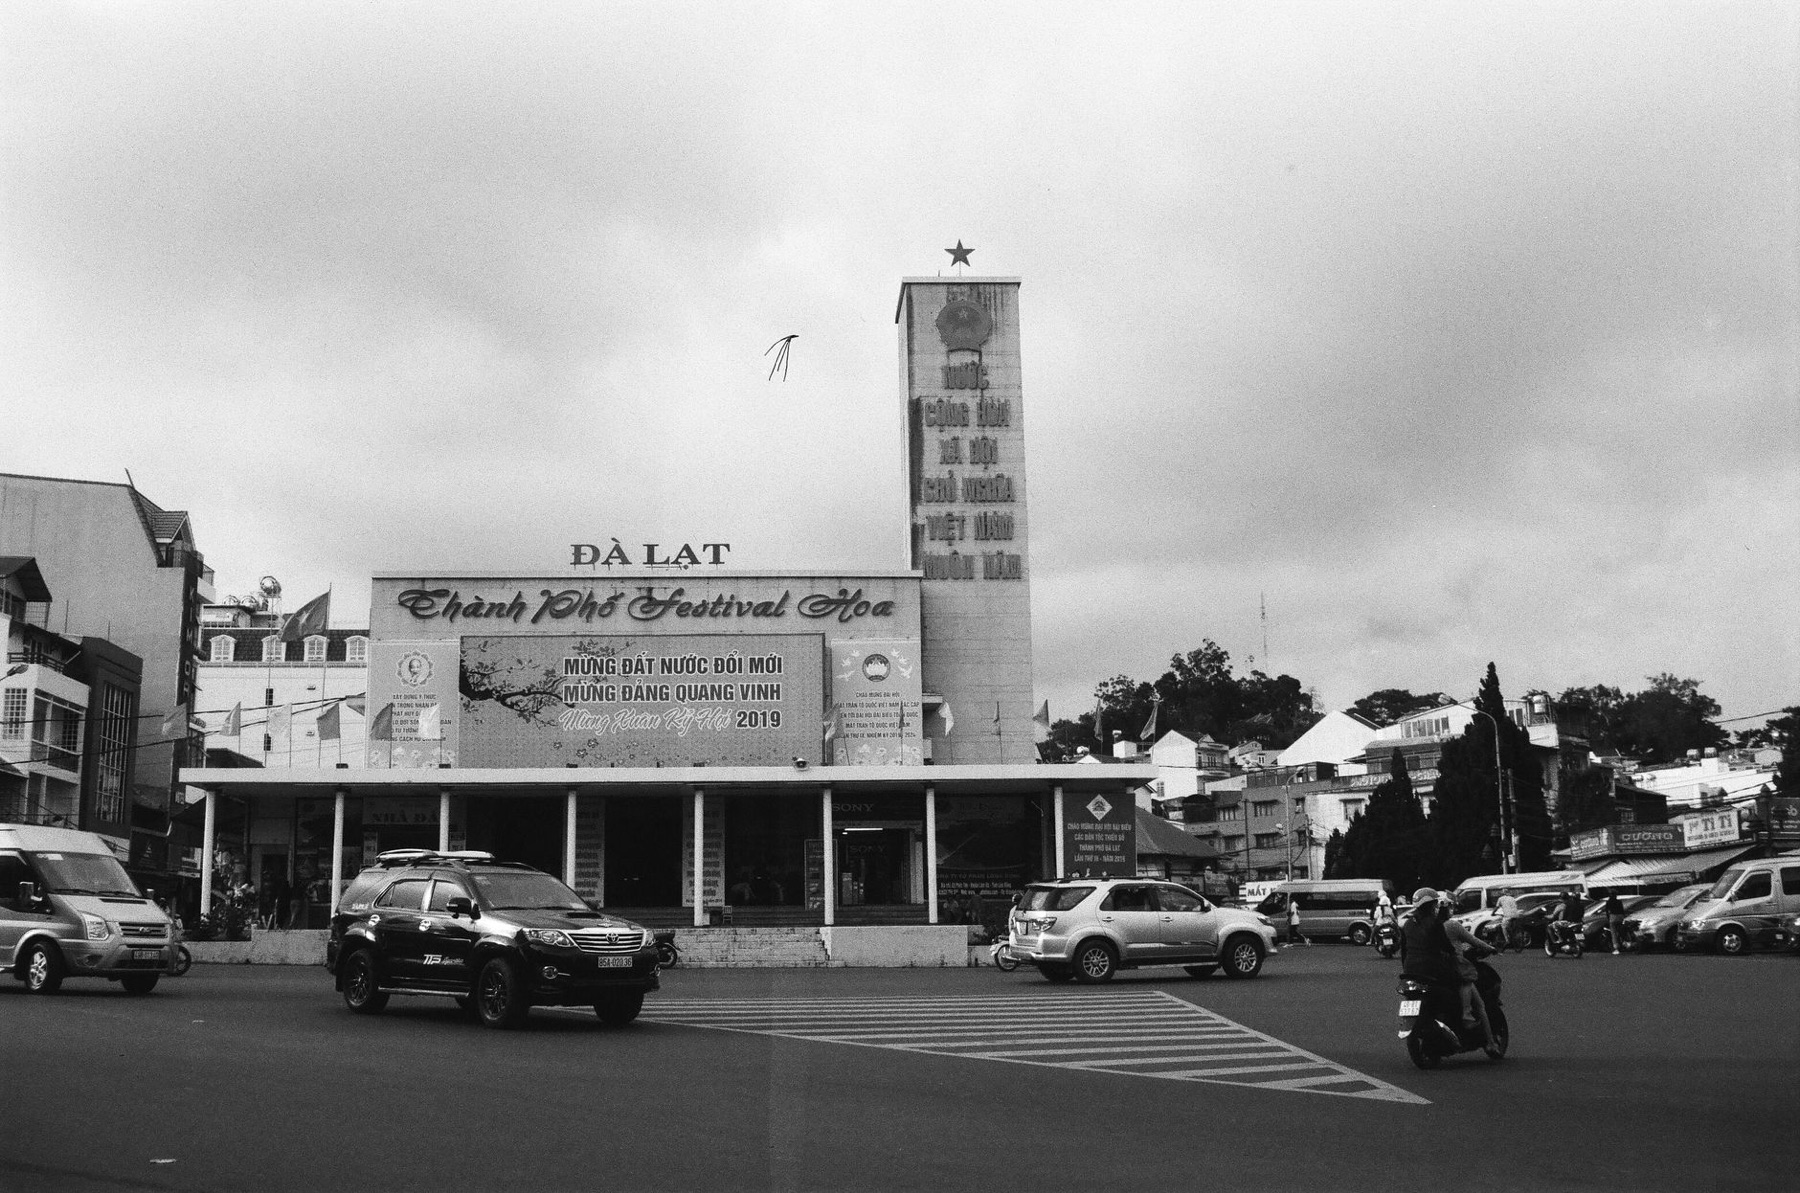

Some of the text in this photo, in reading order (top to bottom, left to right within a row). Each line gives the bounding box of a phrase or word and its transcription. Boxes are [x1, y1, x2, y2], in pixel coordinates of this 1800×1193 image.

[925, 398, 970, 432] CỘNG
[940, 436, 962, 464] XÃ
[924, 470, 1015, 503] CHỦ NGHĨA
[926, 511, 1013, 546] VIỆT NAM
[570, 537, 731, 570] ĐÀ LẠT
[923, 550, 1022, 580] MUÔN NĂM
[398, 587, 895, 623] Thành Phố Festival Hoa
[564, 650, 783, 676] MỪNG ĐẤT NƯỚC ĐỔI MỚI
[563, 678, 781, 703] MỪNG ĐẢNG QUANG VINH
[560, 708, 611, 735] Mừng
[612, 708, 661, 733] Xuân
[736, 710, 781, 729] 2019
